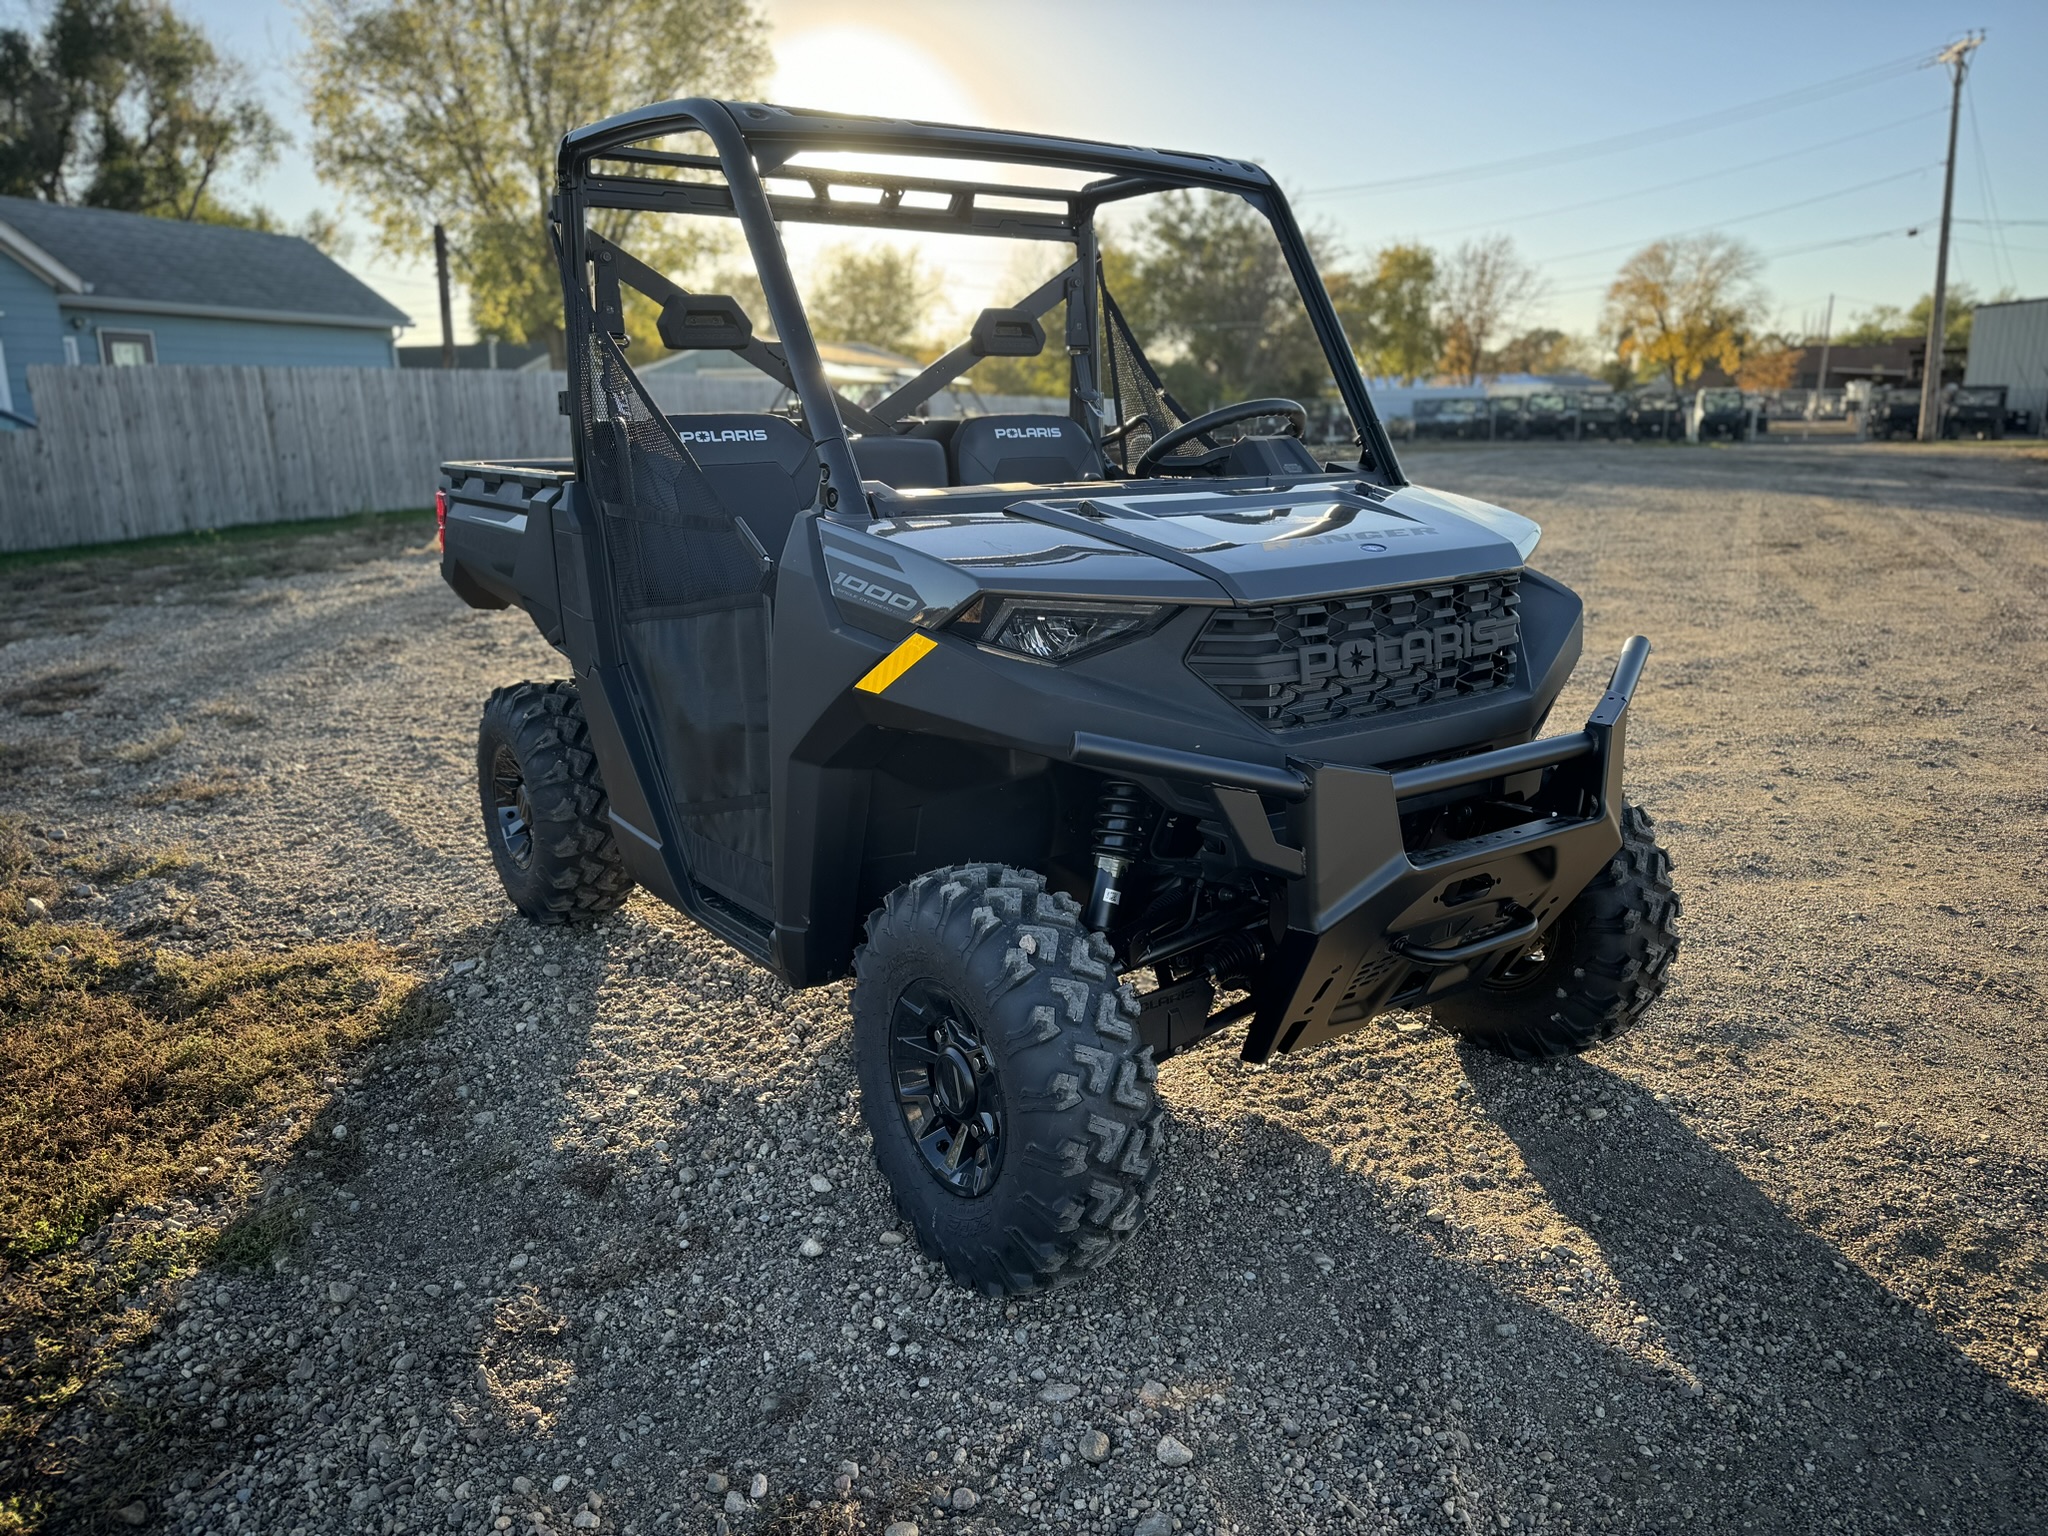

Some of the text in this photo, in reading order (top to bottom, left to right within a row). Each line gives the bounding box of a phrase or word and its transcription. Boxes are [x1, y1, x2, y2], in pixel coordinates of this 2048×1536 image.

[679, 429, 768, 443] POLARIS
[994, 427, 1062, 439] POLARIS
[1261, 527, 1440, 553] RANGER
[833, 571, 918, 611] 1000
[1298, 617, 1500, 685] POLARIS
